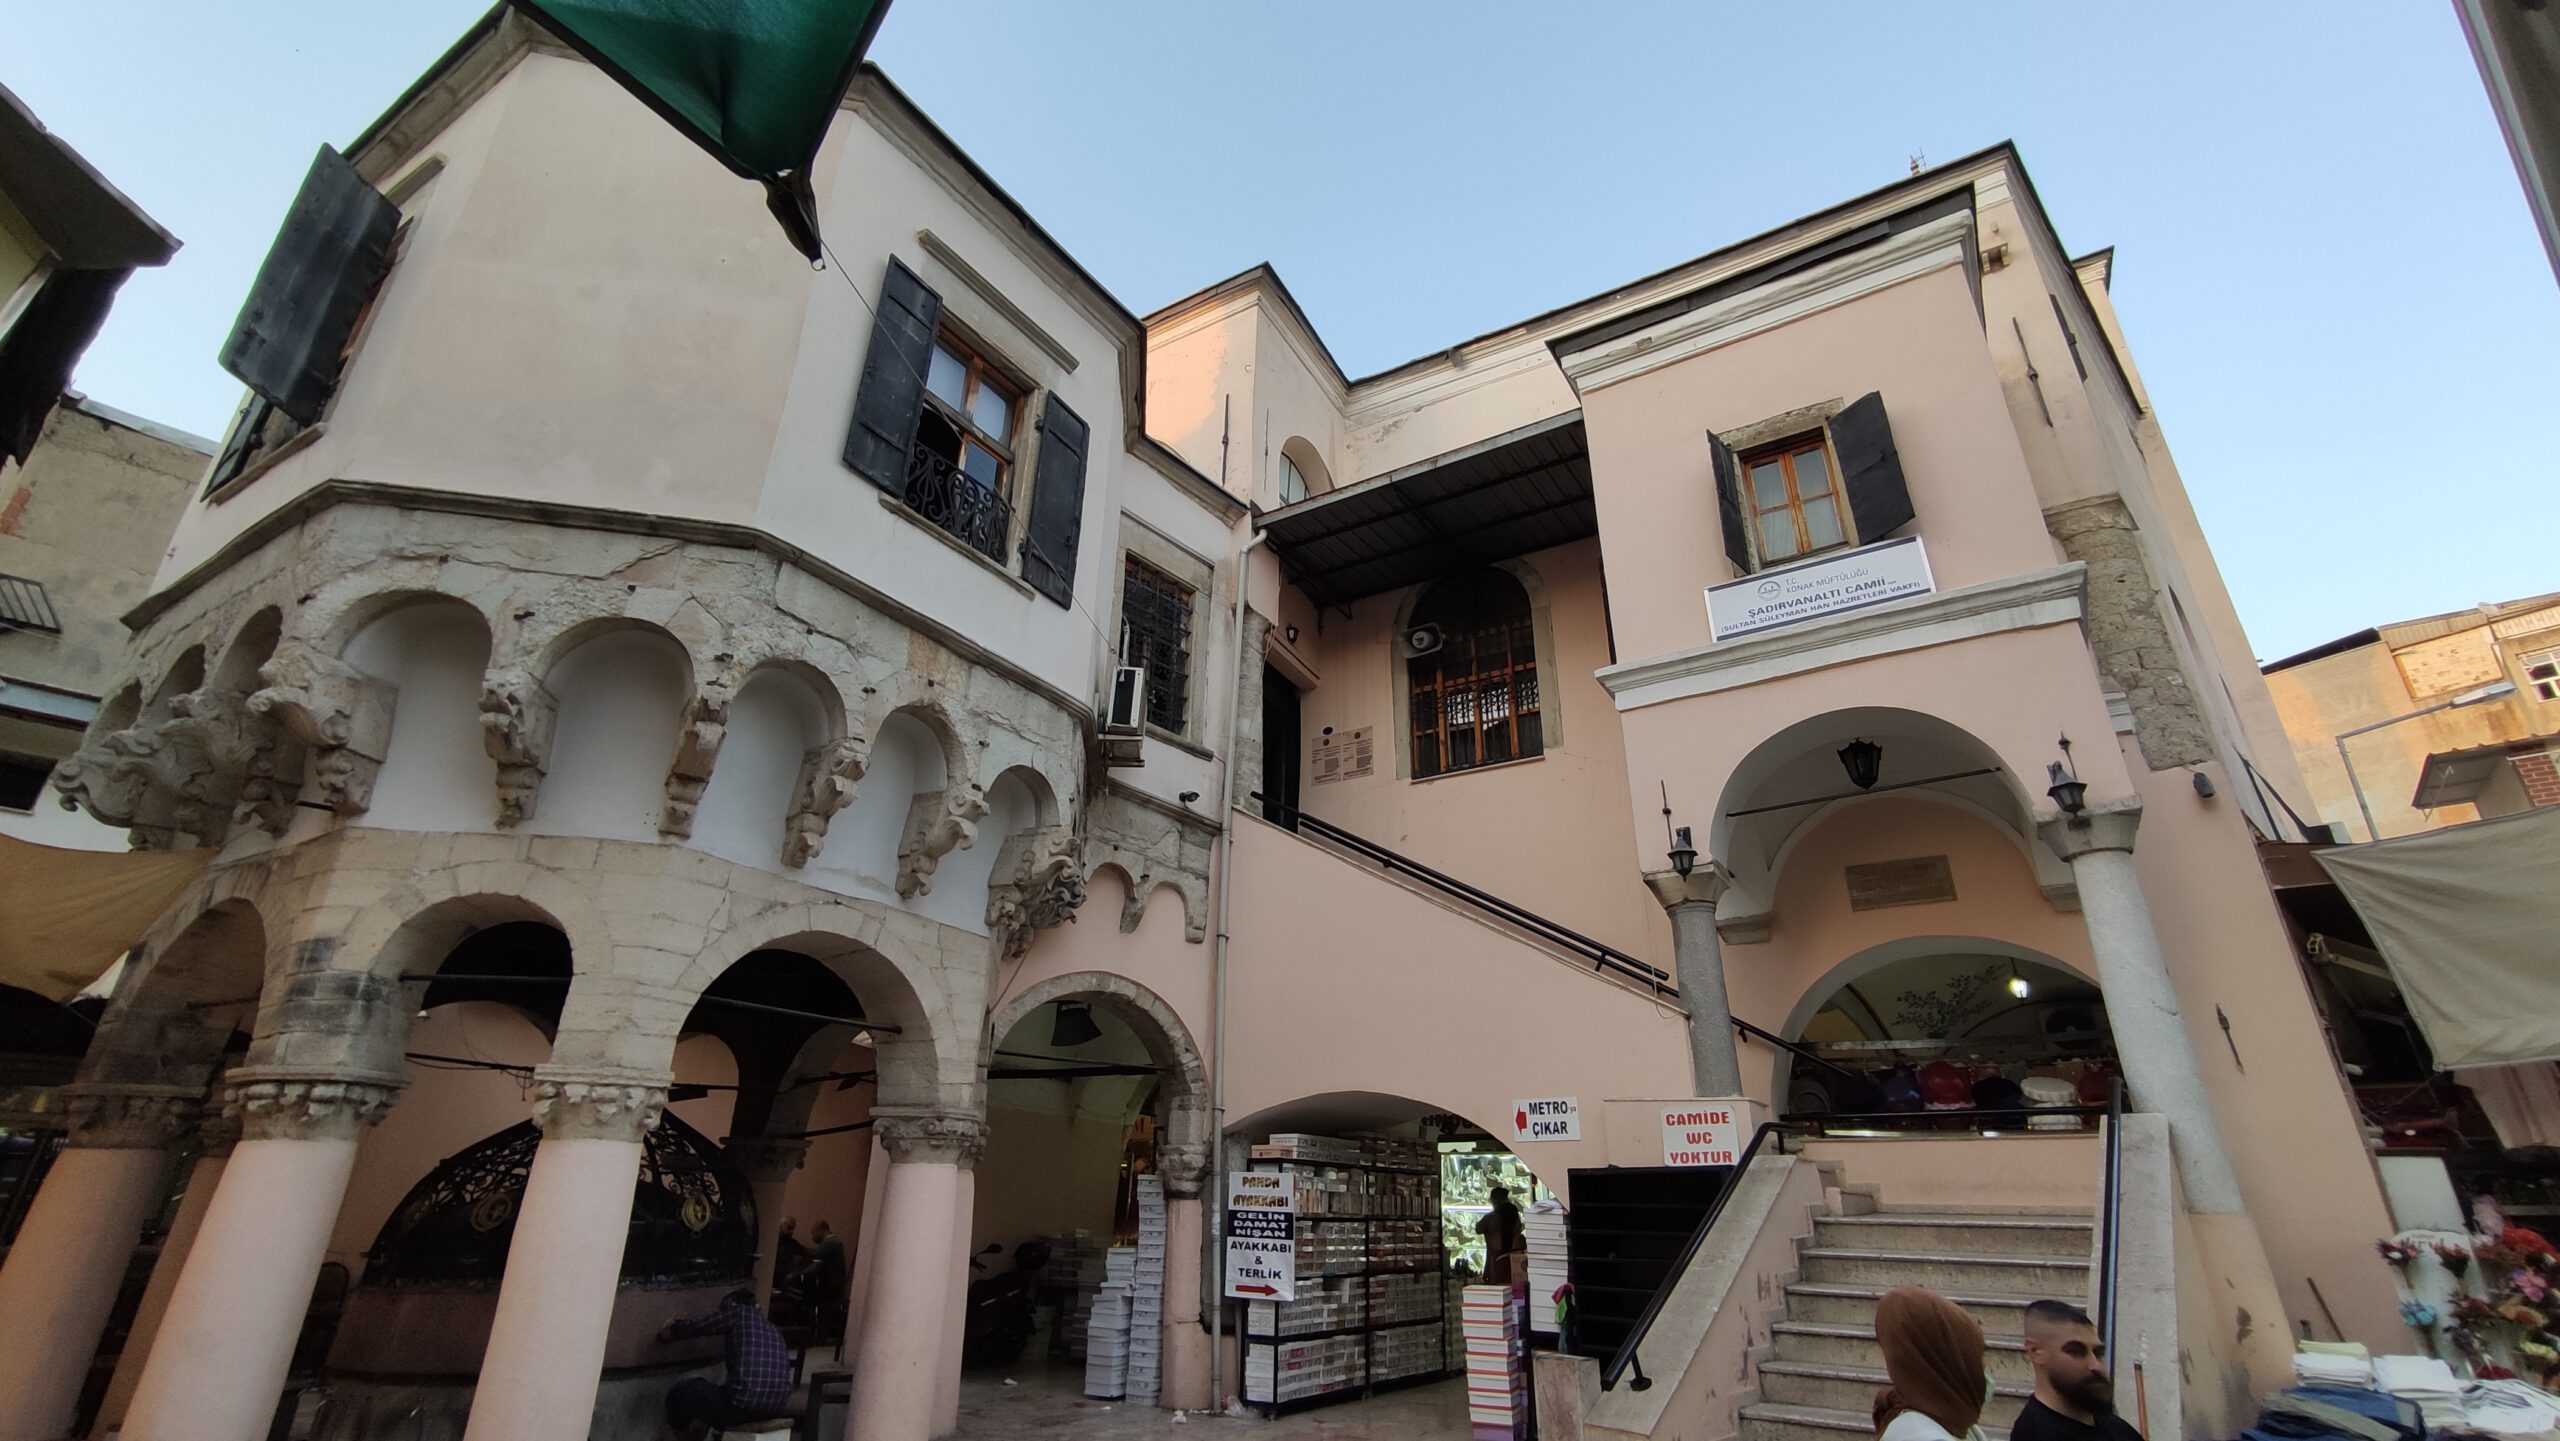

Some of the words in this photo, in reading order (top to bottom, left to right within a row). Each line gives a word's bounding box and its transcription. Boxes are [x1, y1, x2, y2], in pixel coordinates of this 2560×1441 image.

[1786, 582, 1814, 594] KONAK
[1816, 568, 1869, 587] MÜFTÜLÜĞÜ
[1748, 589, 1841, 618] ŞADIRVANALTI
[1845, 577, 1886, 594] CAMİİ
[1759, 607, 1808, 624] SÜLEYMAN
[1810, 602, 1830, 612] HAN
[1833, 589, 1888, 607] HAZRETLERİ
[1529, 1100, 1568, 1116] METRO
[1666, 1110, 1730, 1127] CAMİDE
[1532, 1121, 1569, 1139] ÇIKAR
[1686, 1132, 1713, 1145] WC
[1670, 1150, 1733, 1164] YOKTUR
[1242, 1176, 1280, 1189] PANDA
[1233, 1194, 1289, 1208] AYAKKABI
[1236, 1211, 1285, 1221] GELİN
[1233, 1220, 1289, 1229] DAMAT
[1235, 1228, 1286, 1238] NİŞAN
[1230, 1241, 1292, 1253] AYAKKABI
[1254, 1256, 1263, 1265] &
[1238, 1267, 1282, 1280] TERLİK
